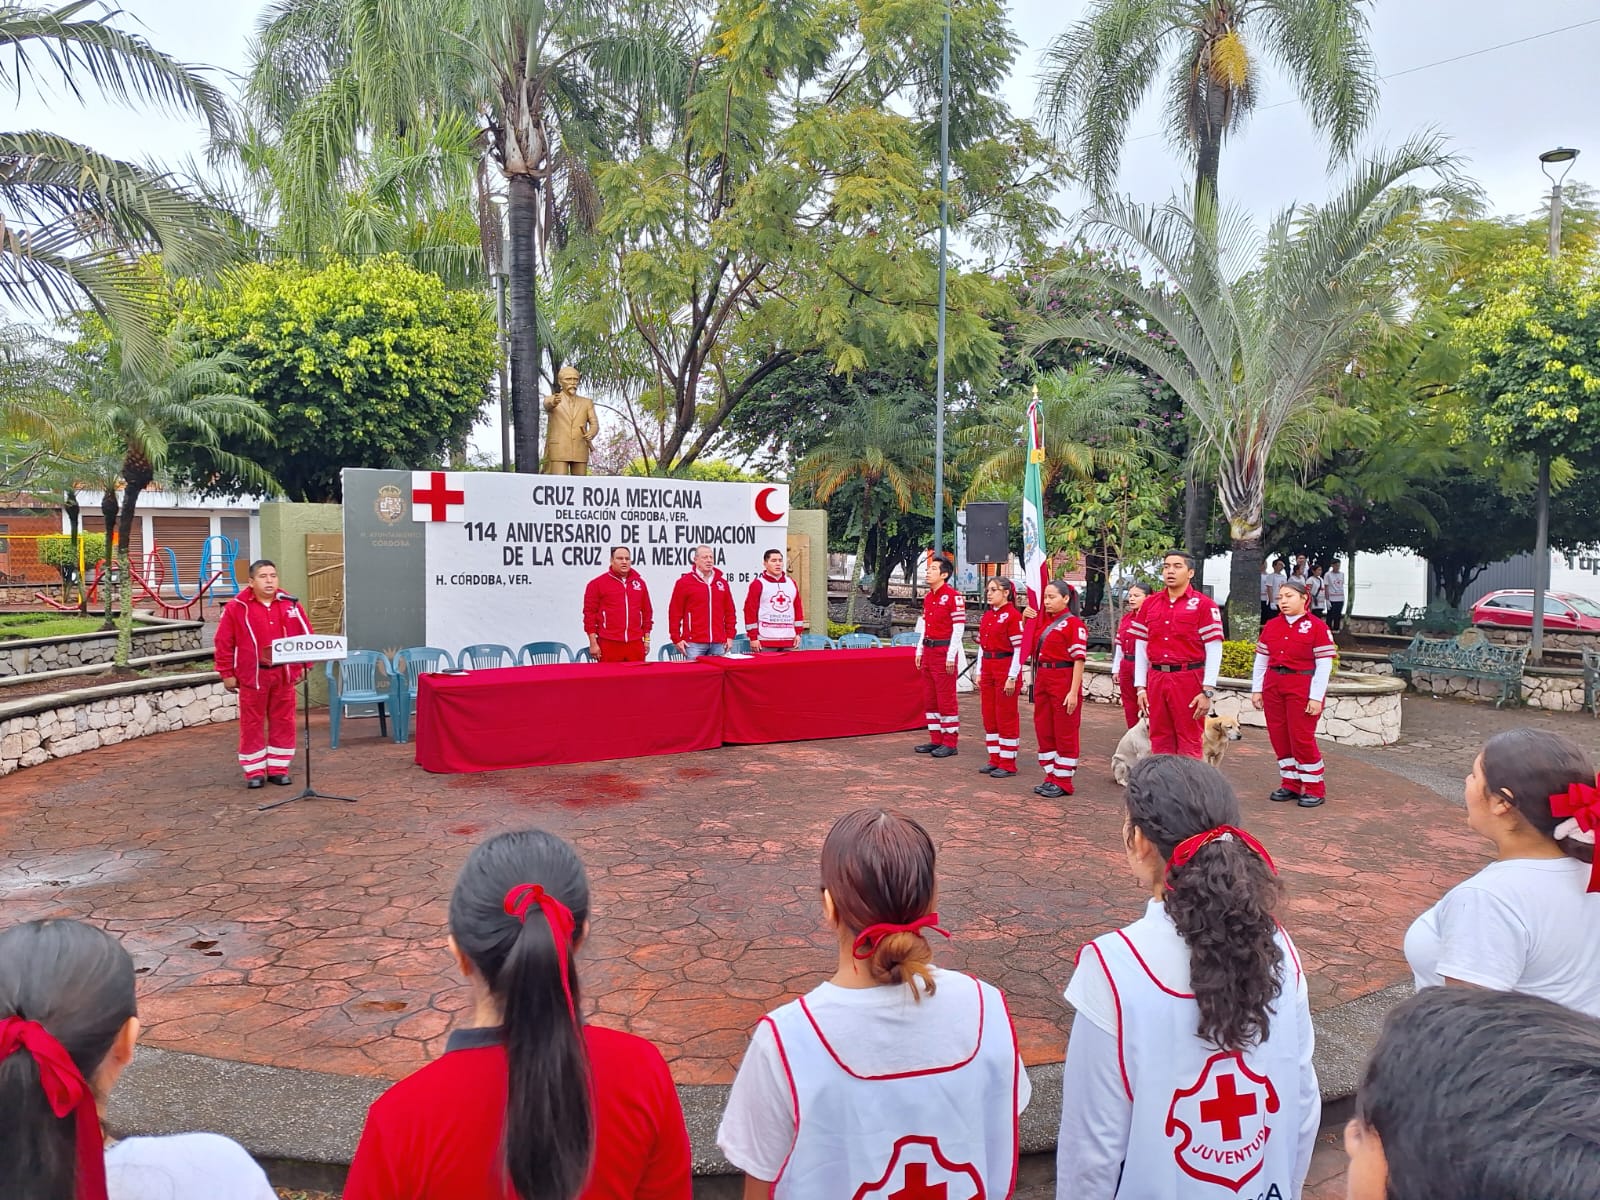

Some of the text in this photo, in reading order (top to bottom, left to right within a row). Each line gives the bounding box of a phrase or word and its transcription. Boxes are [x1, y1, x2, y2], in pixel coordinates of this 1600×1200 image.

[533, 486, 702, 509] CRUZ ROJA MEXICANA
[555, 508, 616, 521] DELEGACIÓN
[464, 521, 756, 544] 114 ANIVERSARIO DE LA FUNDACIÓN
[503, 546, 524, 566] DE
[532, 546, 554, 566] LA
[562, 546, 602, 566] CRUZ
[652, 547, 727, 566] MEXICA
[436, 571, 532, 588] H. CÓRDOBA, VER.
[738, 573, 750, 583] DE
